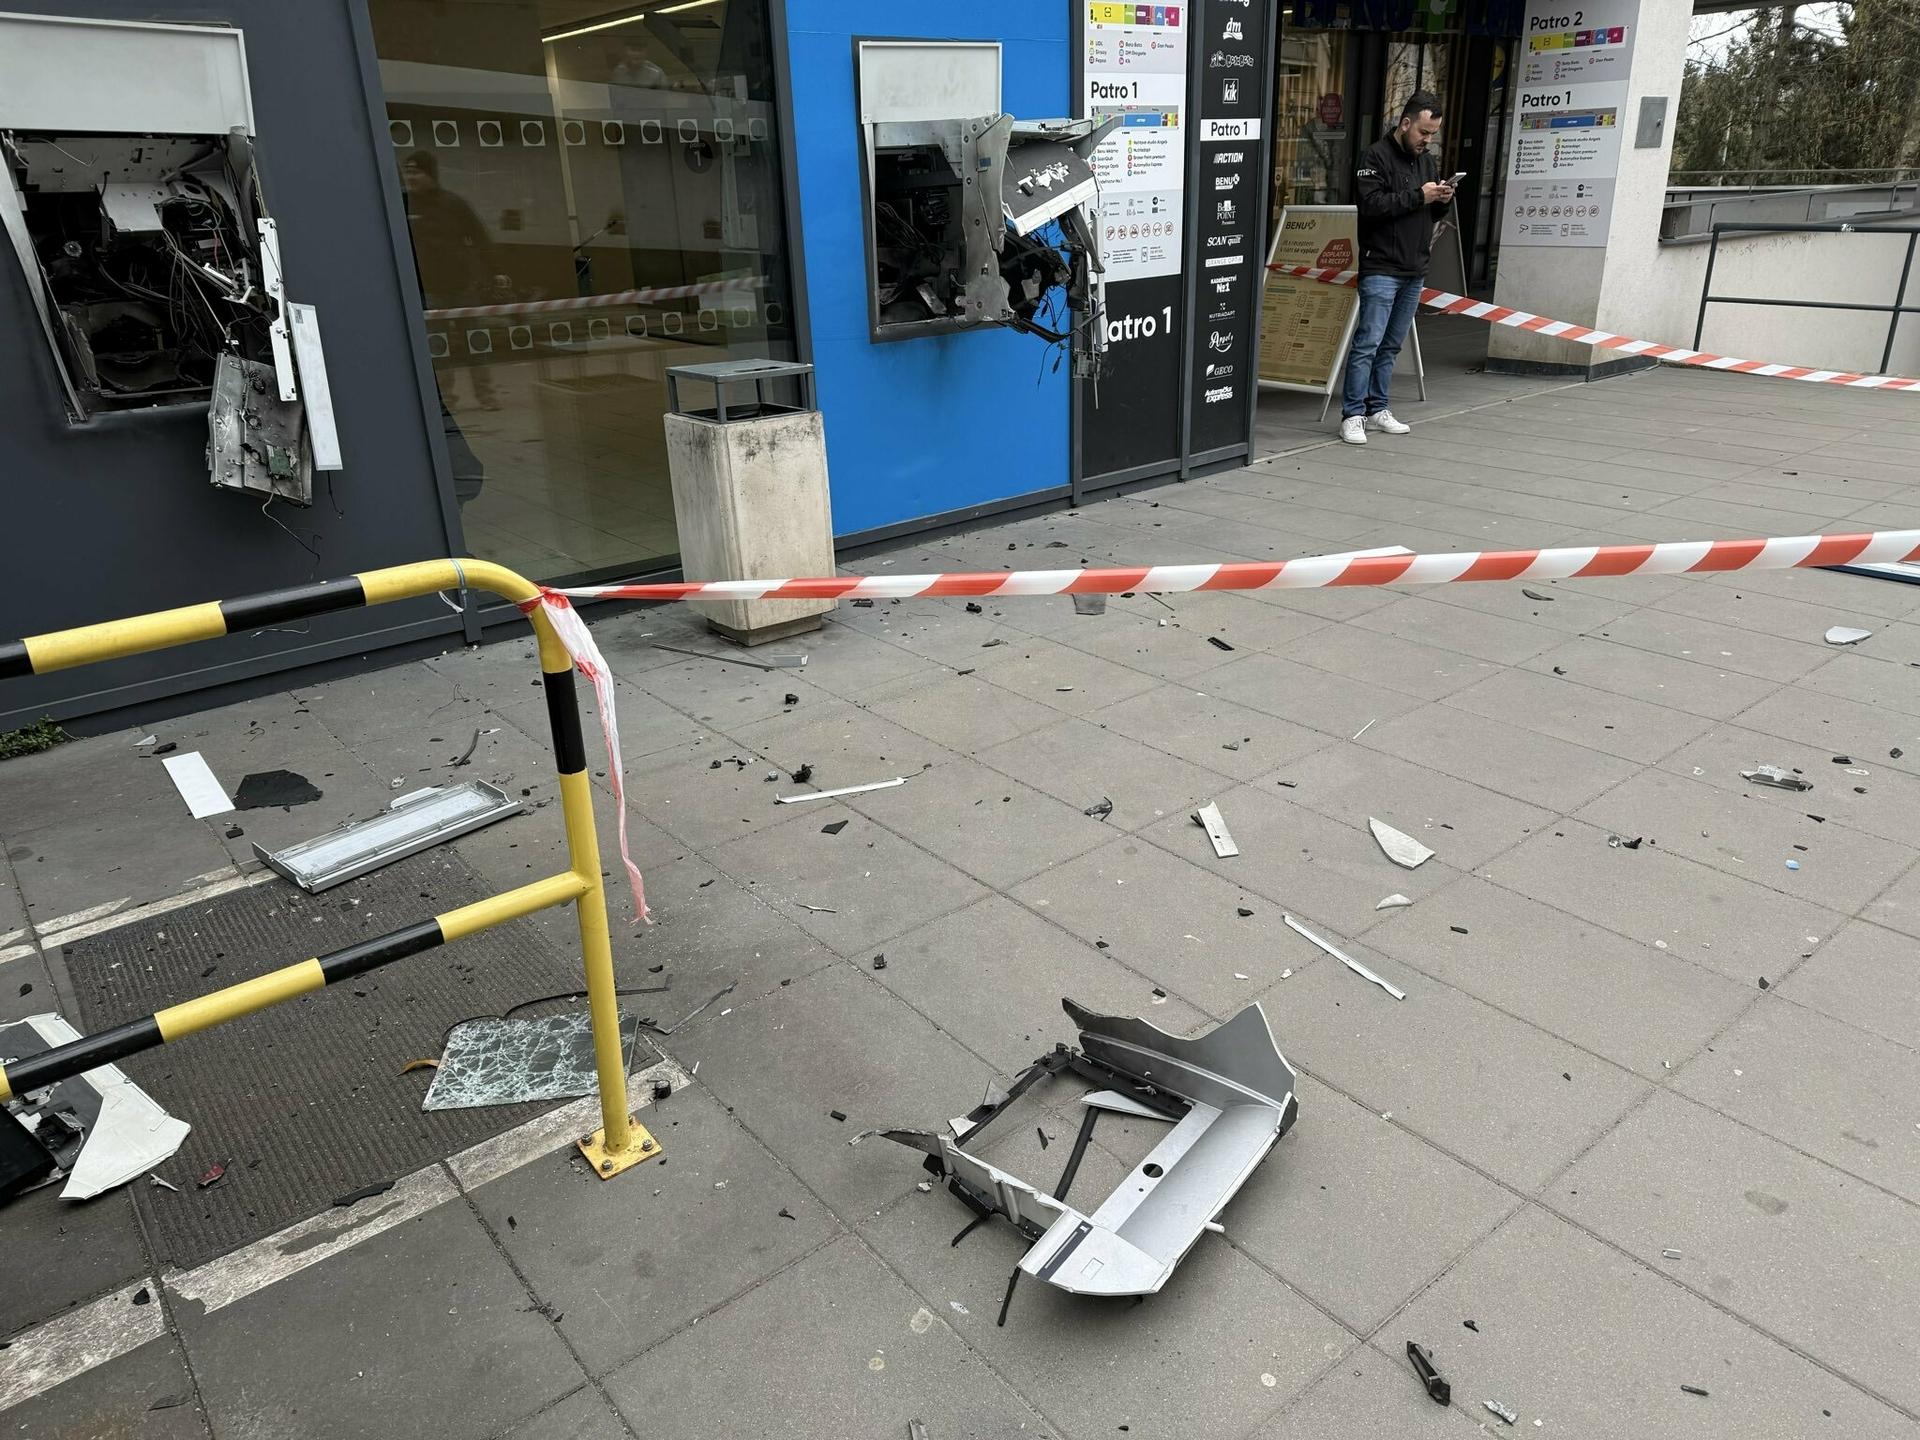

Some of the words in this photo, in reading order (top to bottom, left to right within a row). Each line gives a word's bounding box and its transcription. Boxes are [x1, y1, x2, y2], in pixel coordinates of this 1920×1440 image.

[1226, 17, 1242, 32] dm
[1530, 15, 1570, 30] Patro
[1573, 11, 1583, 26] 2
[1091, 81, 1128, 98] Patro
[1132, 81, 1137, 98] 1
[1522, 94, 1560, 108] Patro
[1565, 91, 1571, 104] 1
[1211, 122, 1240, 136] Patro
[1244, 121, 1248, 135] 1
[1216, 152, 1244, 164] ACTION
[1216, 177, 1233, 185] BENU
[1207, 236, 1226, 246] SCAN
[1106, 314, 1156, 342] atro
[1162, 306, 1172, 334] 1
[1214, 365, 1233, 375] GECO
